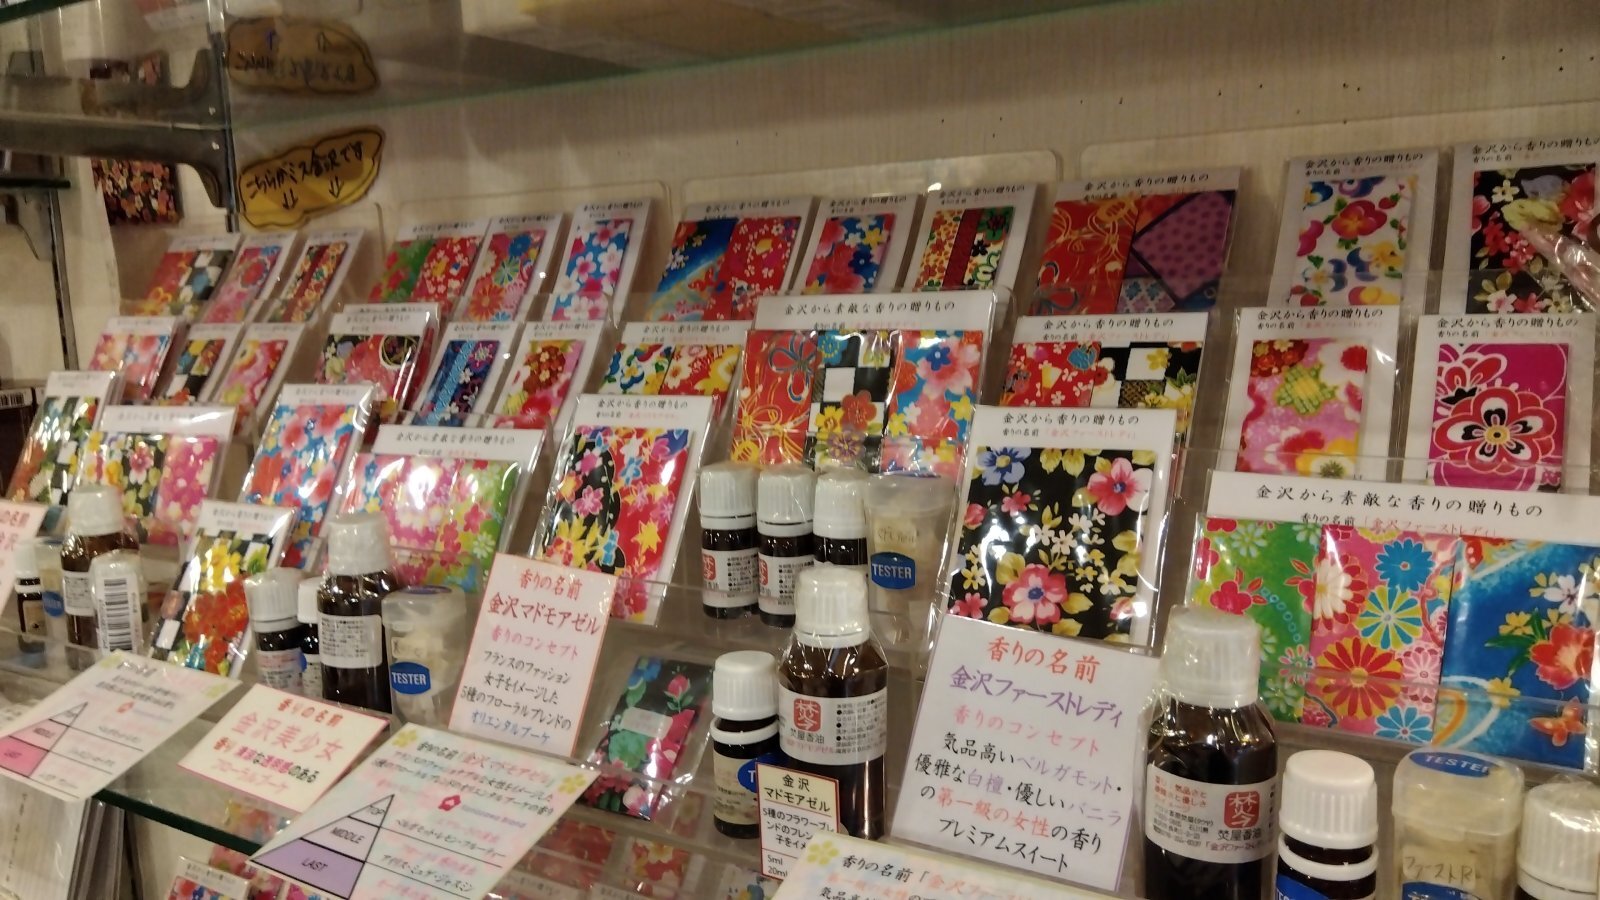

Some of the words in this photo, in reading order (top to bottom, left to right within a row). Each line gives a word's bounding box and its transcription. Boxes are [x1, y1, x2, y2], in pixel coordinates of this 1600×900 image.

[784, 300, 957, 316] 金沢から素敵な香りの贈りもの
[1003, 412, 1139, 426] 金沢から香りの贈りもの
[1256, 484, 1543, 517] 金沢から素敵な香りの贈りもの
[519, 568, 583, 600] 香りの名前
[872, 563, 912, 579] TESTER
[487, 591, 600, 635] 金沢マドモアゼル
[491, 625, 579, 661] 香りのコンセプト
[986, 635, 1101, 684] 香りの名前
[391, 671, 427, 686] TESTER
[483, 651, 571, 685] フランスのファッション
[484, 672, 559, 705] 女子をイメージした
[950, 664, 1122, 729] 金沢ファーストレディ
[460, 685, 572, 730] 5種のフローラルブレンドの
[232, 711, 343, 761] 金沢美少女
[954, 704, 1099, 757] 香りのコンセプト
[763, 787, 831, 812] マドモアゼル
[782, 774, 810, 792] 金沢
[915, 752, 1122, 827] 優雅な白檀・優しいバニラ
[329, 826, 366, 845] MIDDLE
[920, 783, 1103, 855] の第一級の女性の香り
[767, 854, 783, 866] 5ml
[939, 817, 1068, 874] プレミアムスイート
[300, 857, 328, 872] LAST
[767, 865, 788, 878] 20ml
[842, 855, 913, 883] 香りの名前
